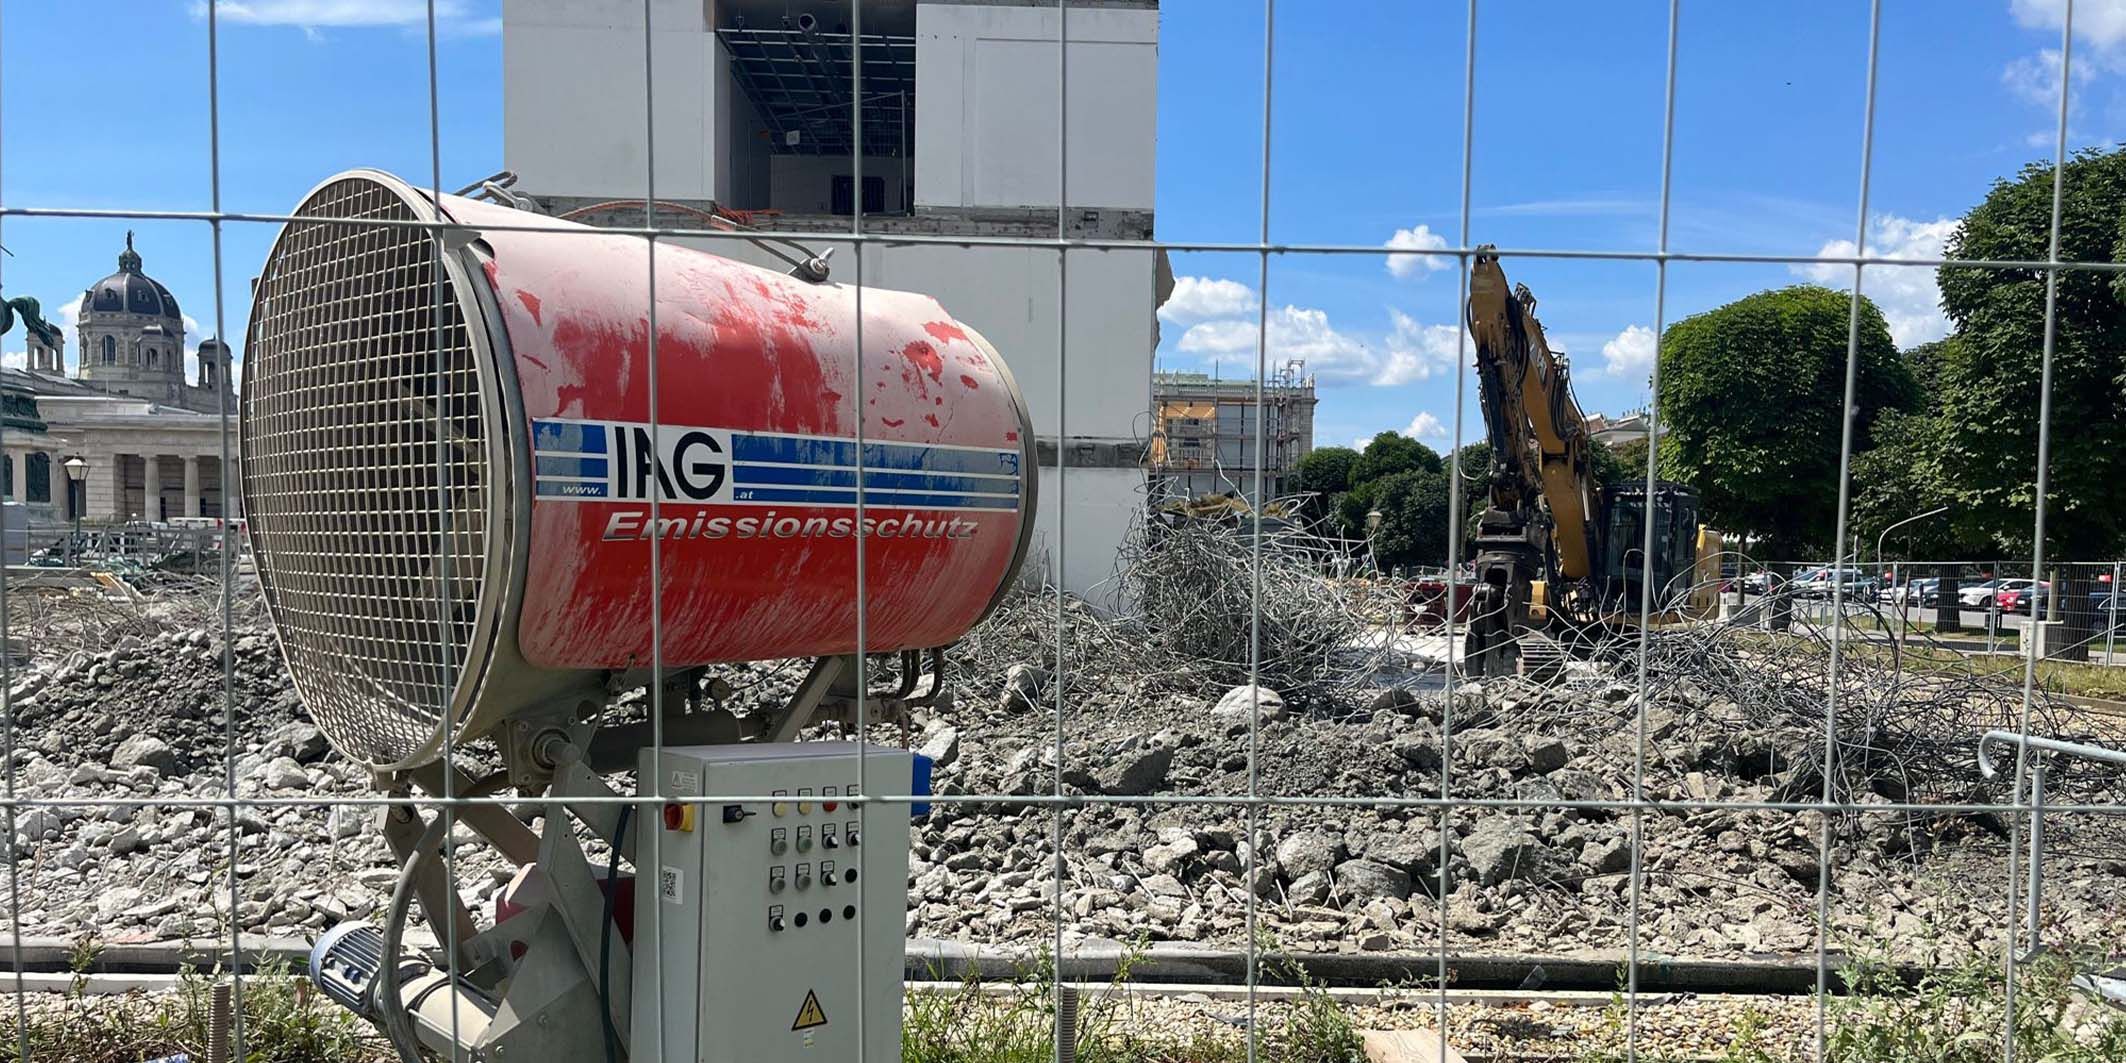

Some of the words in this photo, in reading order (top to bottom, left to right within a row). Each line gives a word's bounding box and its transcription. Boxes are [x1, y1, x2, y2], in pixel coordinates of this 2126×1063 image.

[562, 485, 602, 495] www.
[614, 426, 726, 500] IAG
[735, 489, 754, 500] .at
[601, 510, 980, 542] Emissionsschutz
